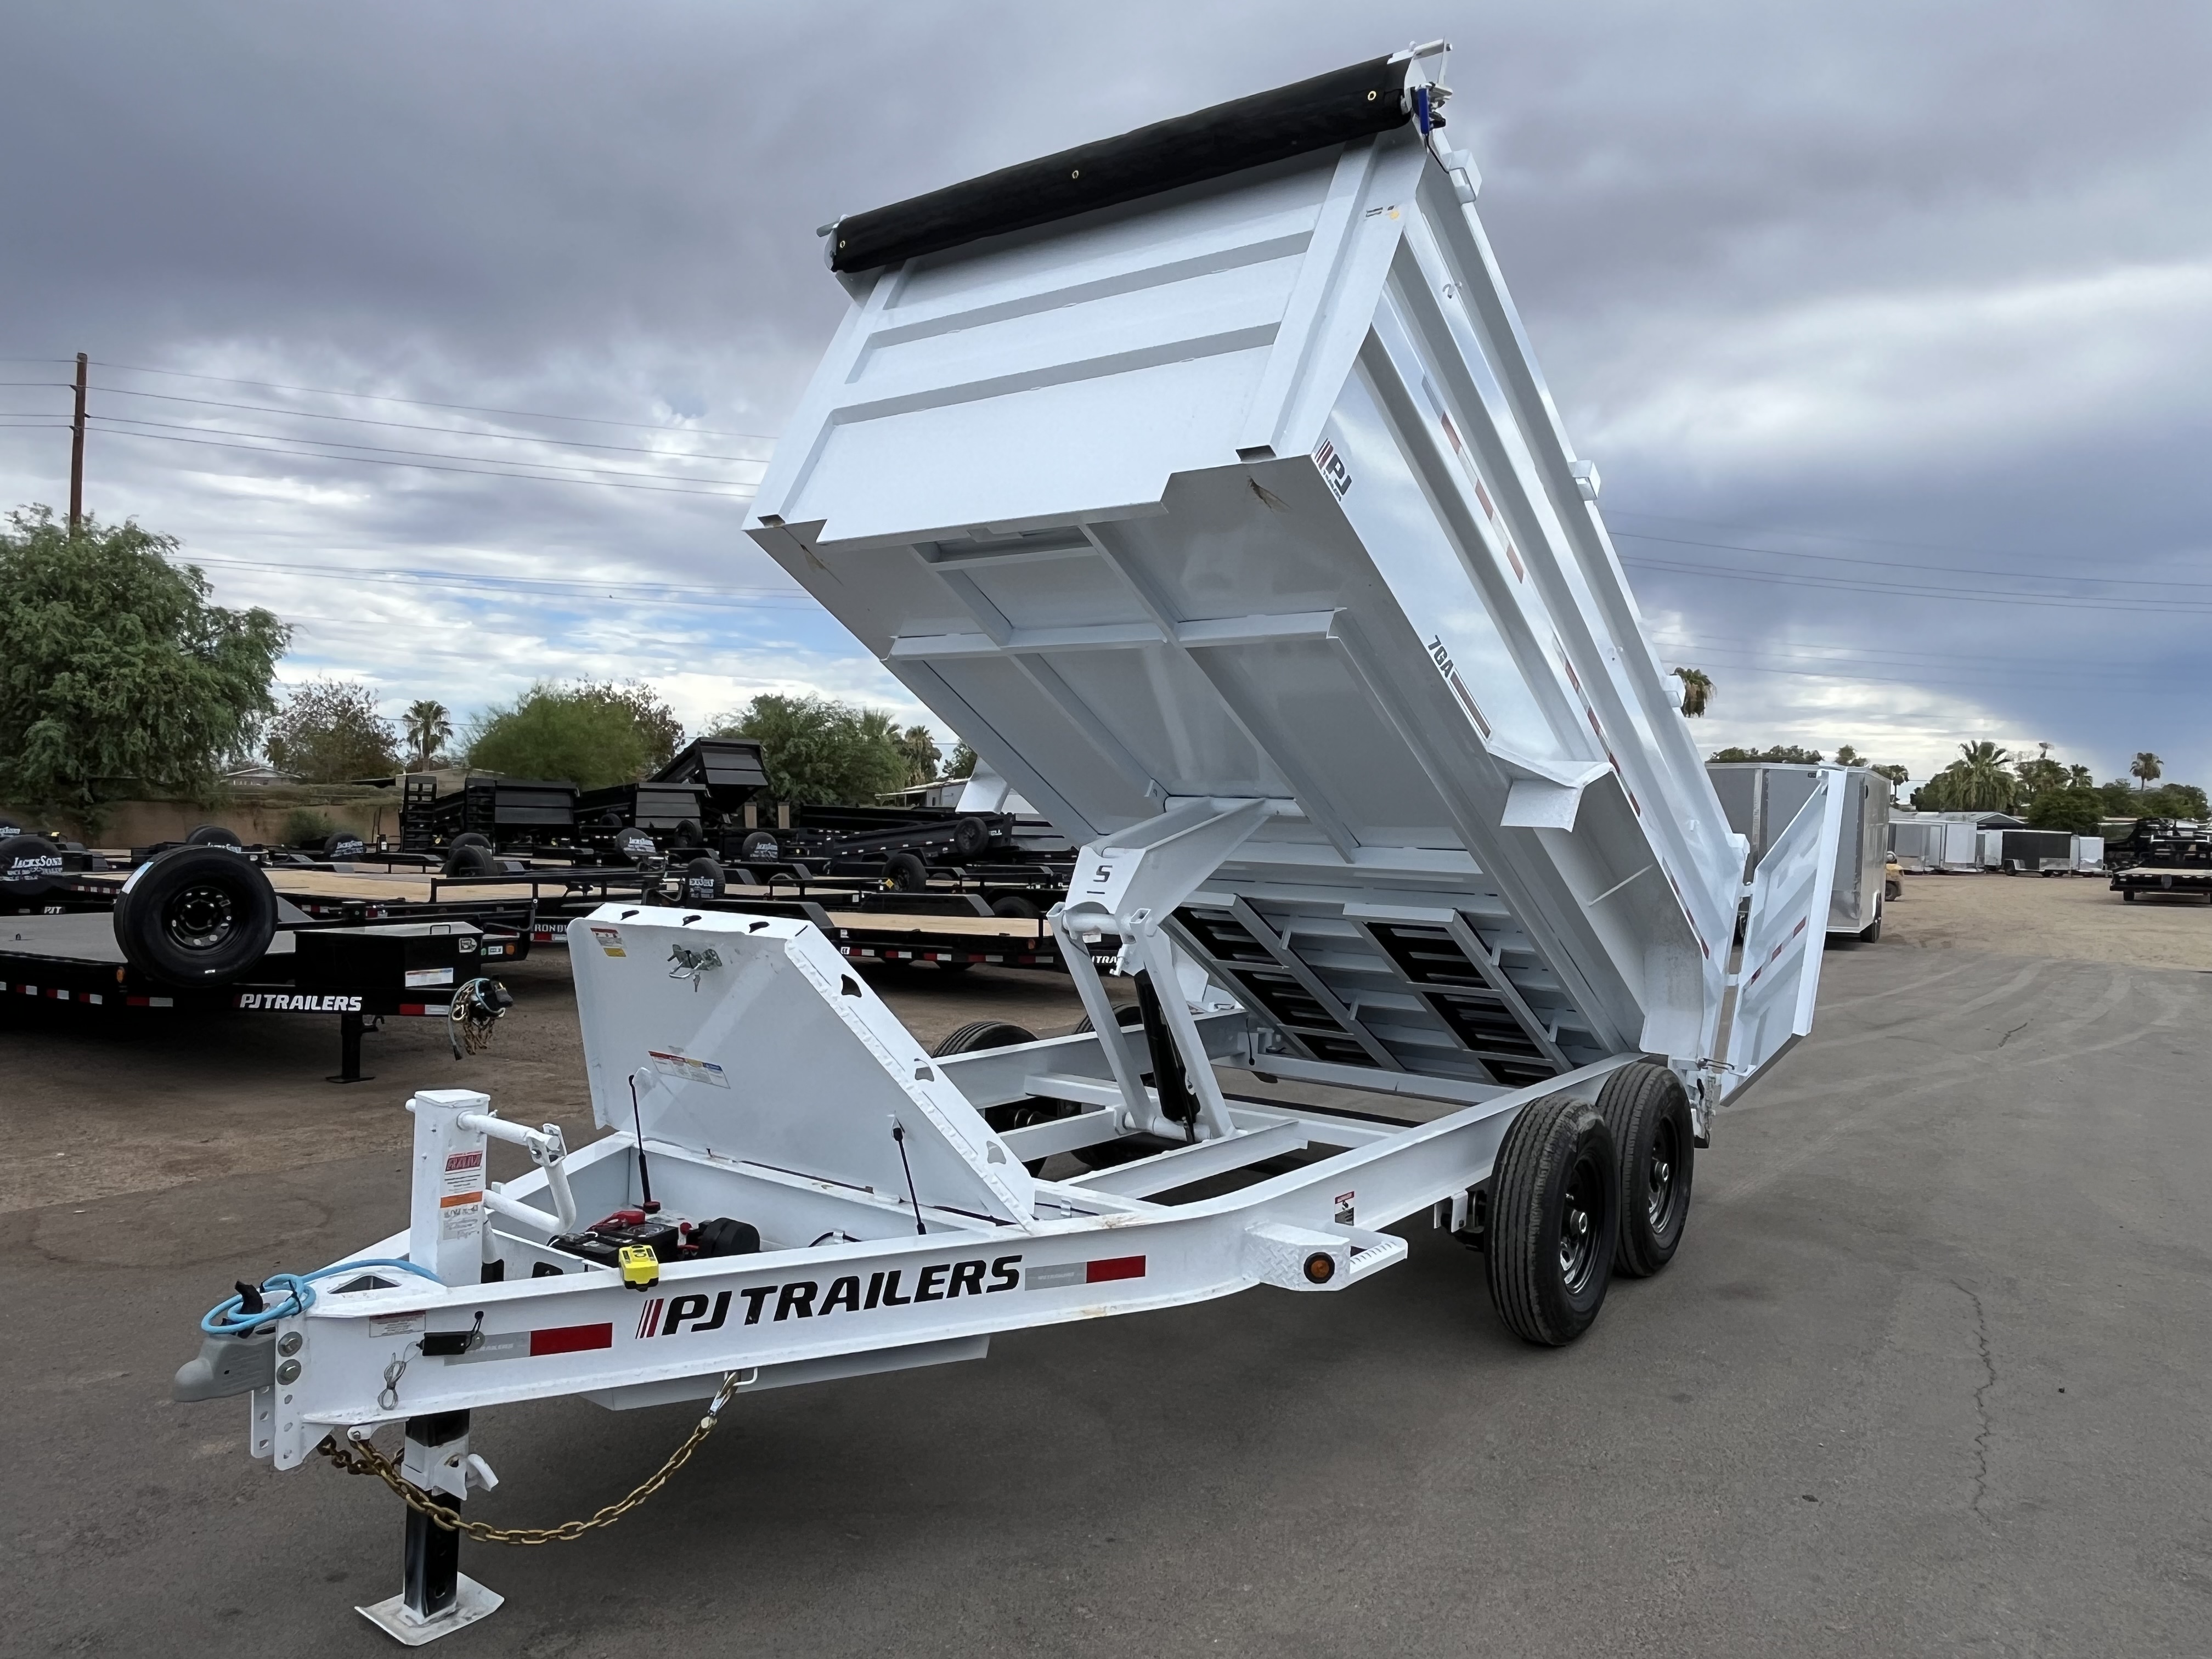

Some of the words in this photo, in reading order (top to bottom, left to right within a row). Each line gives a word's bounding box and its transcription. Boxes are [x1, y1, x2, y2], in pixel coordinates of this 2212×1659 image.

[1325, 453, 1352, 496] PJ
[1427, 634, 1454, 678] 7GA
[263, 994, 363, 1011] TRAILERS
[741, 1254, 1023, 1325] TRAILERS
